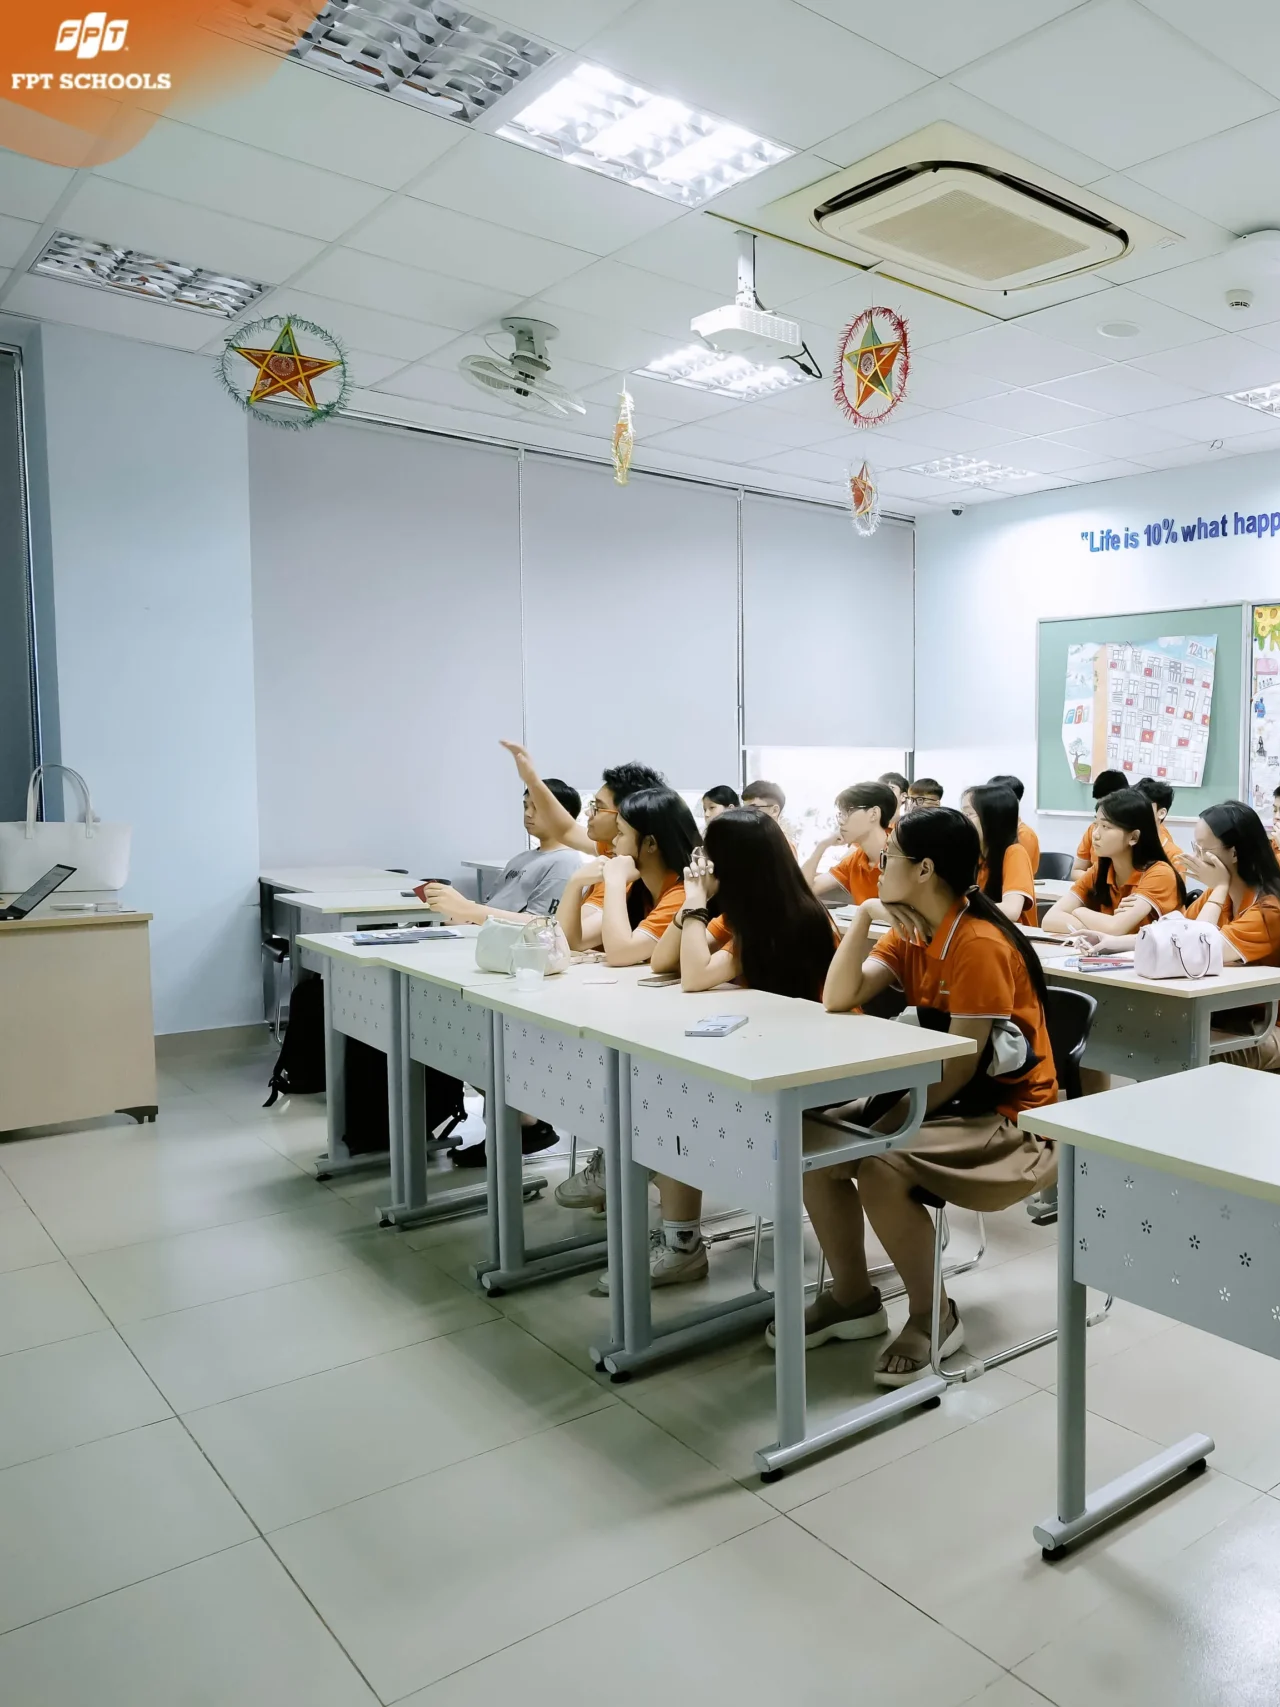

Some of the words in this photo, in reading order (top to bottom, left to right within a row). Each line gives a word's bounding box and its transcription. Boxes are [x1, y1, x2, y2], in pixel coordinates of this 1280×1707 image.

[1124, 528, 1139, 549] is
[1144, 518, 1178, 547] 10%
[1180, 513, 1228, 542] what
